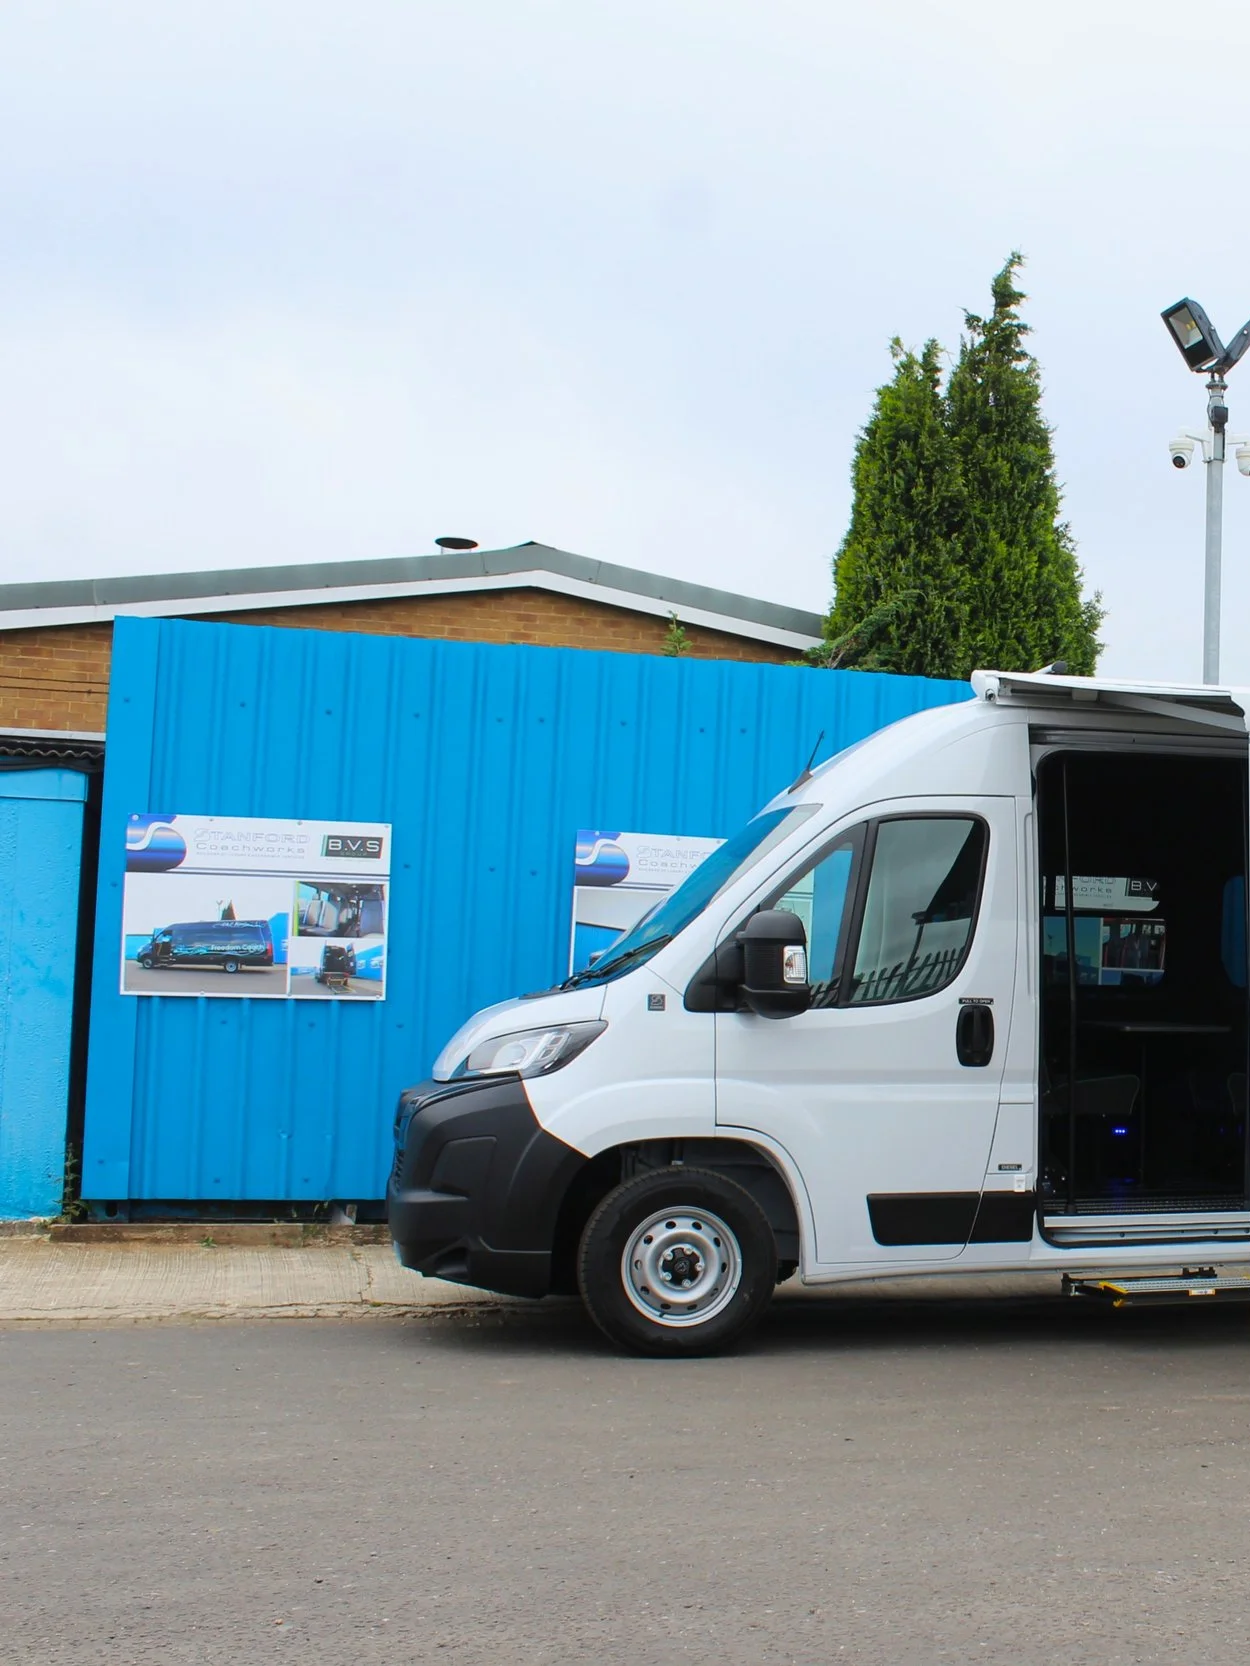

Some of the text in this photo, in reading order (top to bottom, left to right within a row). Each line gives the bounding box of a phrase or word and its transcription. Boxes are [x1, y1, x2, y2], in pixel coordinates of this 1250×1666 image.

[193, 828, 310, 844] STANFORD
[196, 842, 305, 853] Coachworks
[328, 839, 380, 852] B.V.S
